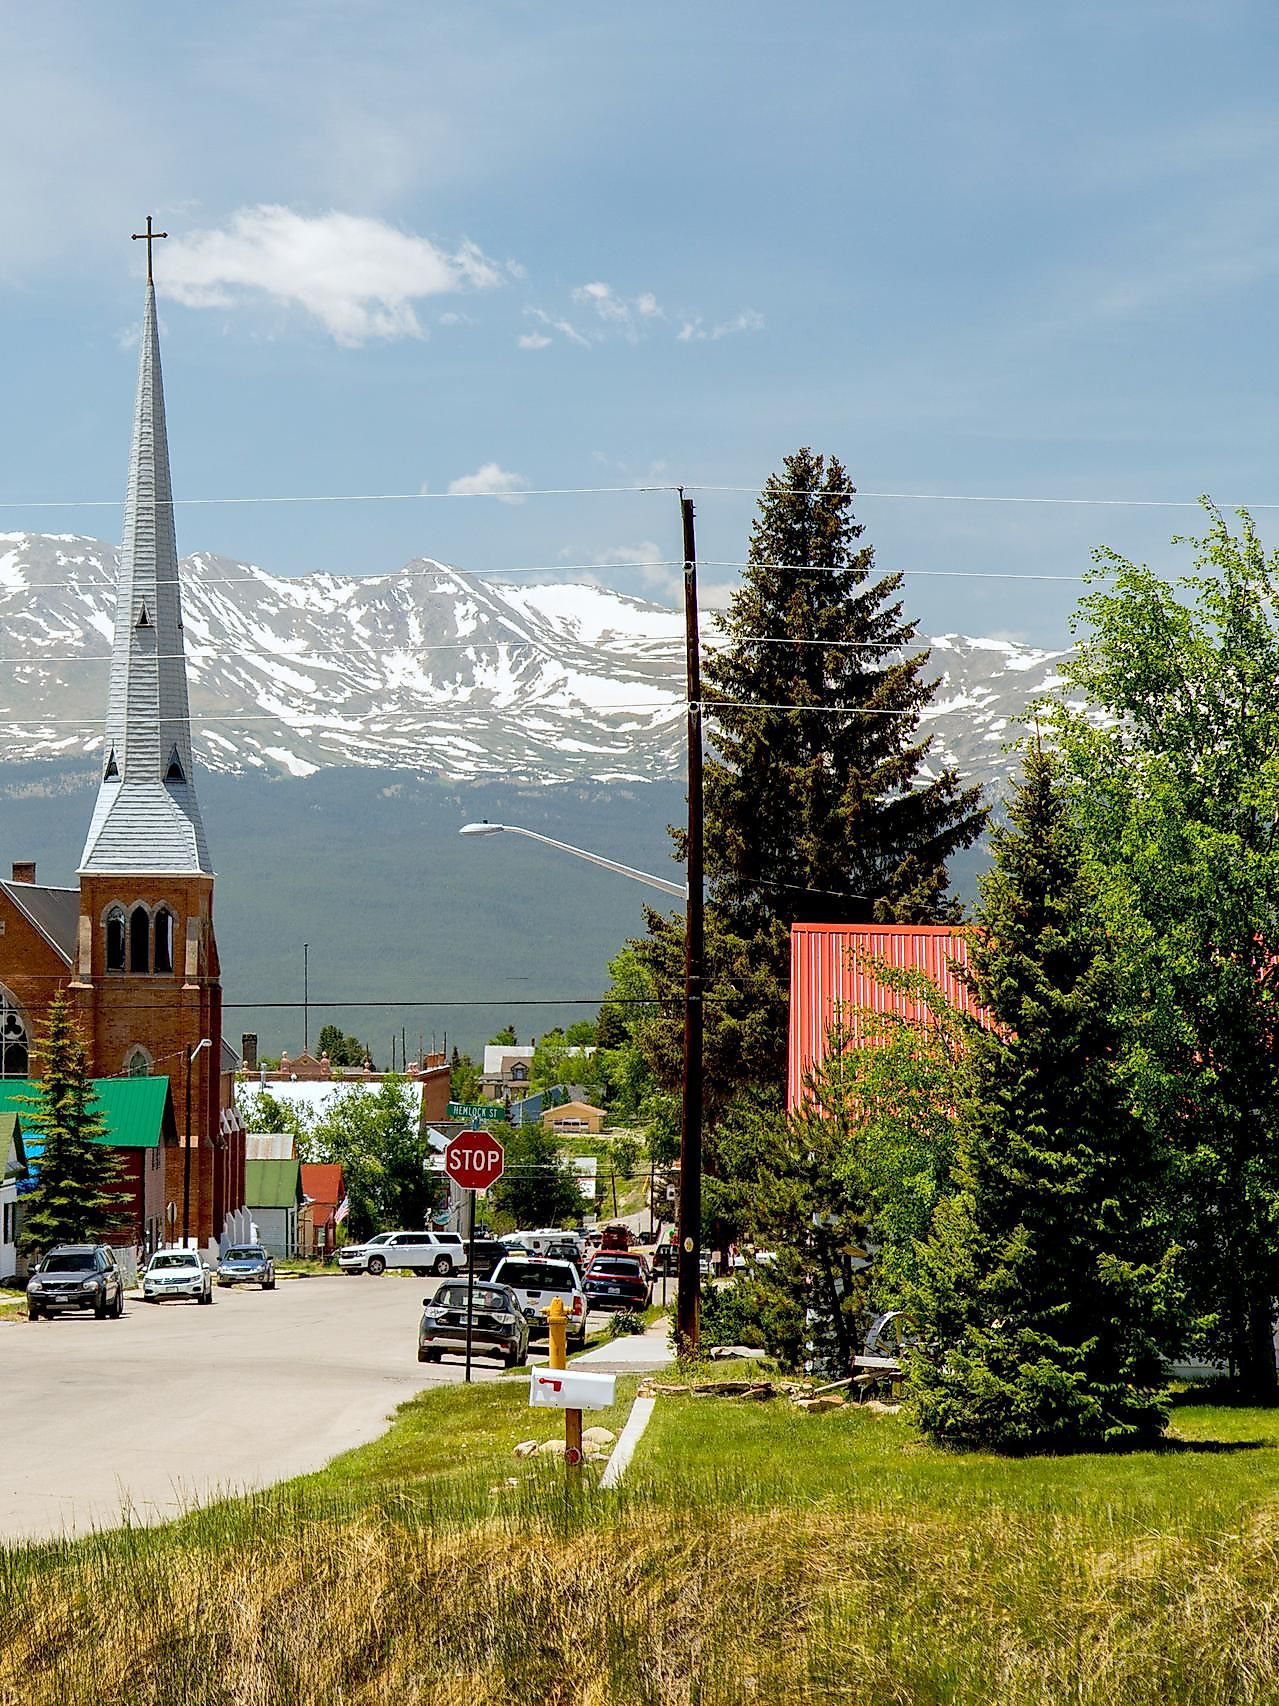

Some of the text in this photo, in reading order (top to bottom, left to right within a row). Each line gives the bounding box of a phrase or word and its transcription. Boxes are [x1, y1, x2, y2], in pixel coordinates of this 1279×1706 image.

[453, 1106, 498, 1118] HEMLOCK ST
[450, 1149, 499, 1171] STOP
